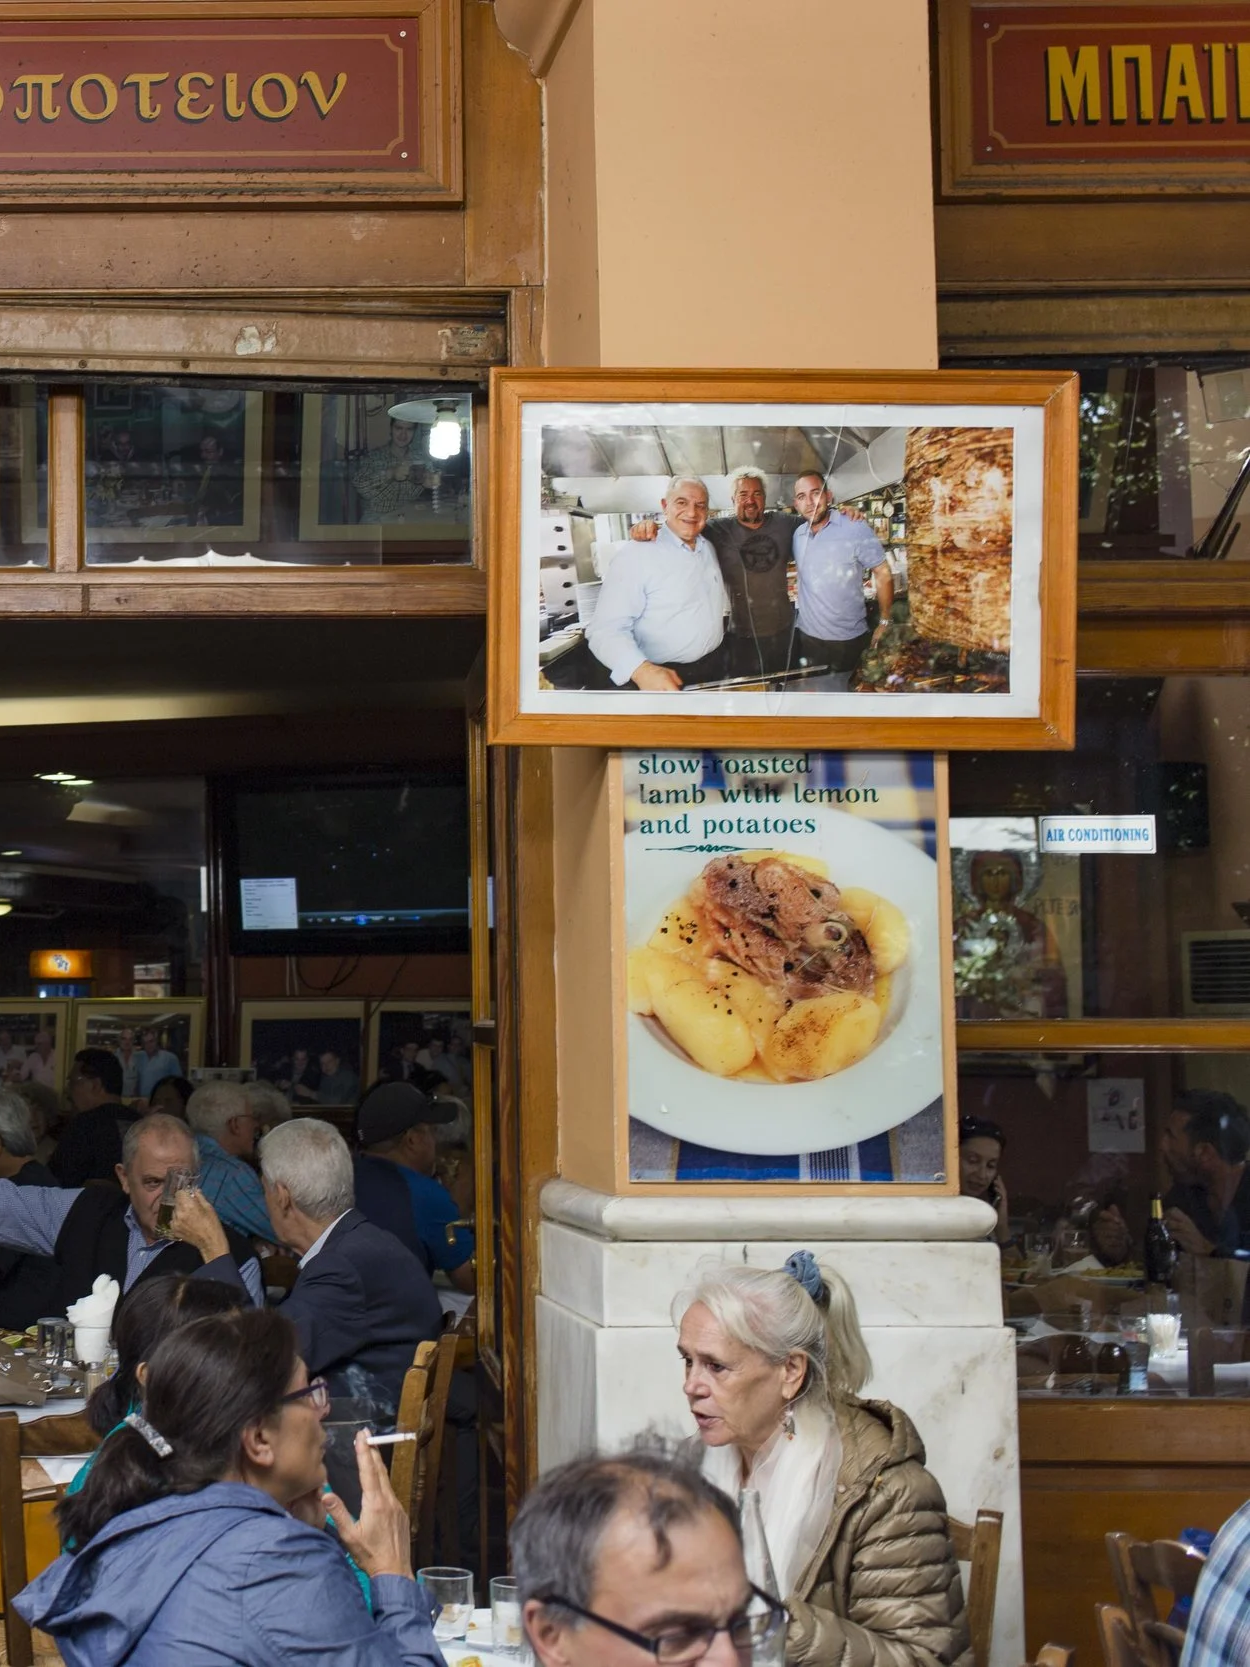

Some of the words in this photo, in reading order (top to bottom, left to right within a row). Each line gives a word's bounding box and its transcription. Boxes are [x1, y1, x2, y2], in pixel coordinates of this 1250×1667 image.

[638, 752, 813, 775] slow-roasted
[639, 783, 706, 804] lamb
[719, 783, 782, 804] with
[794, 783, 880, 804] lemon
[639, 813, 691, 835] and
[703, 817, 817, 840] potatoes
[1046, 828, 1065, 842] AIR
[1068, 828, 1150, 842] CONDITIONING
